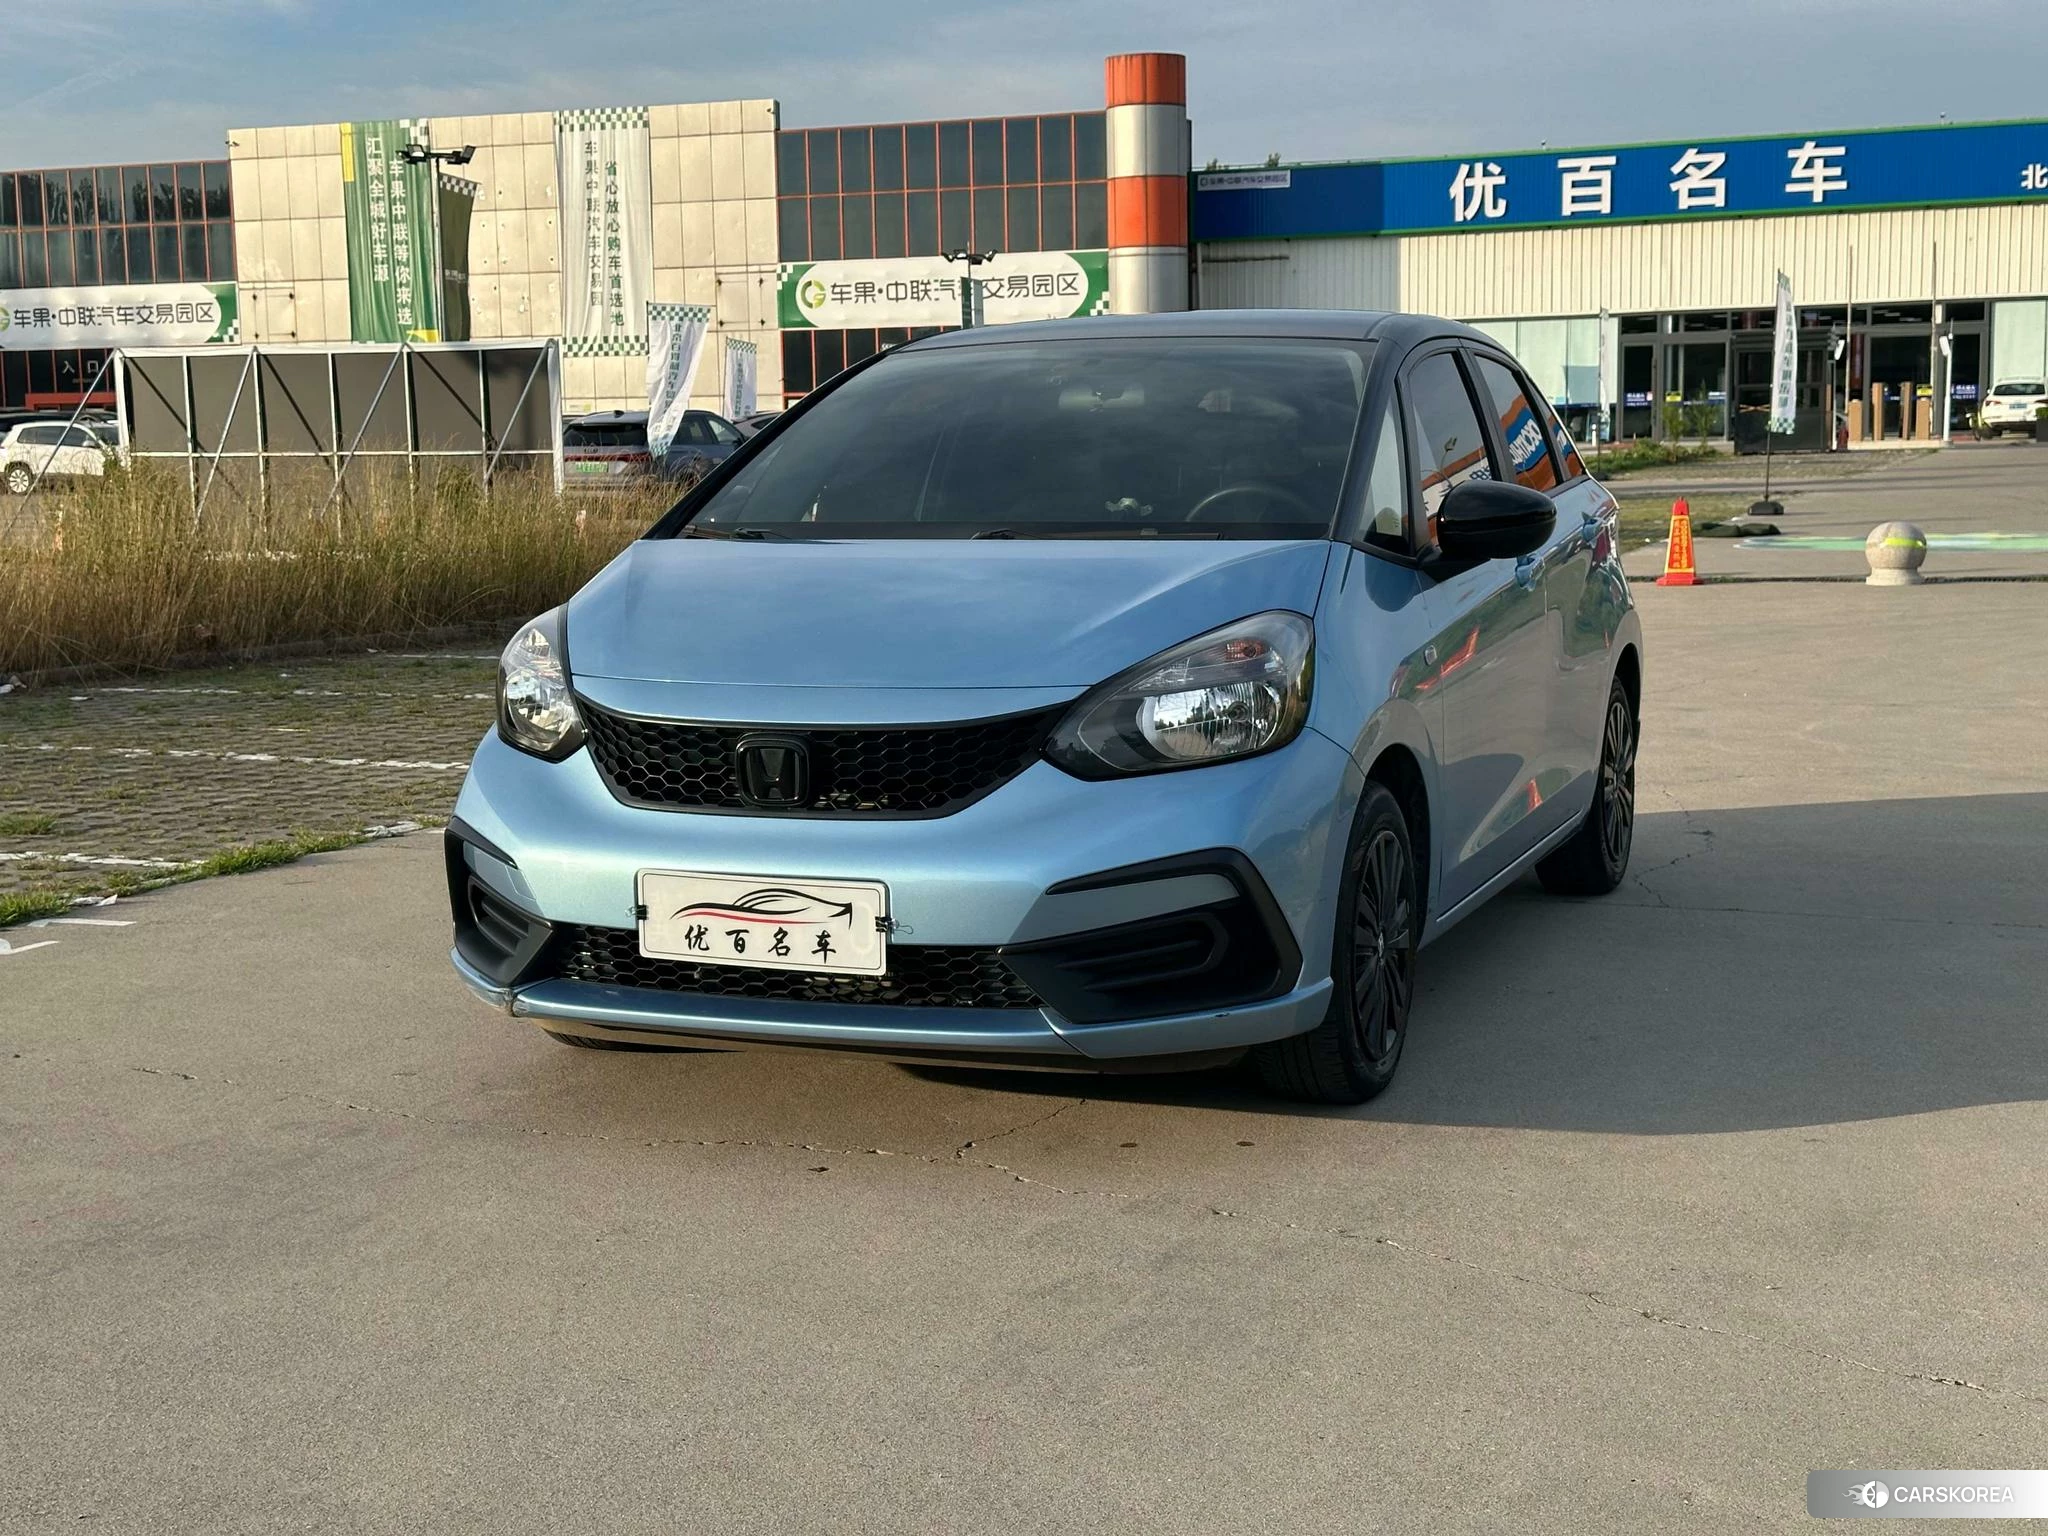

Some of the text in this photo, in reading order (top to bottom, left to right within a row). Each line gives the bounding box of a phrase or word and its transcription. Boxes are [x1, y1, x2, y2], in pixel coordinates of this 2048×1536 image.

[1449, 141, 1848, 222] 优百名车
[2020, 163, 2048, 190] 北
[605, 161, 624, 326] 省心放心购车首选地
[830, 272, 1080, 305] 车果·中联汽交易园区
[13, 302, 215, 328] 车果·中联汽车交易园区
[62, 360, 99, 375] 入口
[684, 924, 836, 964] 优百名车
